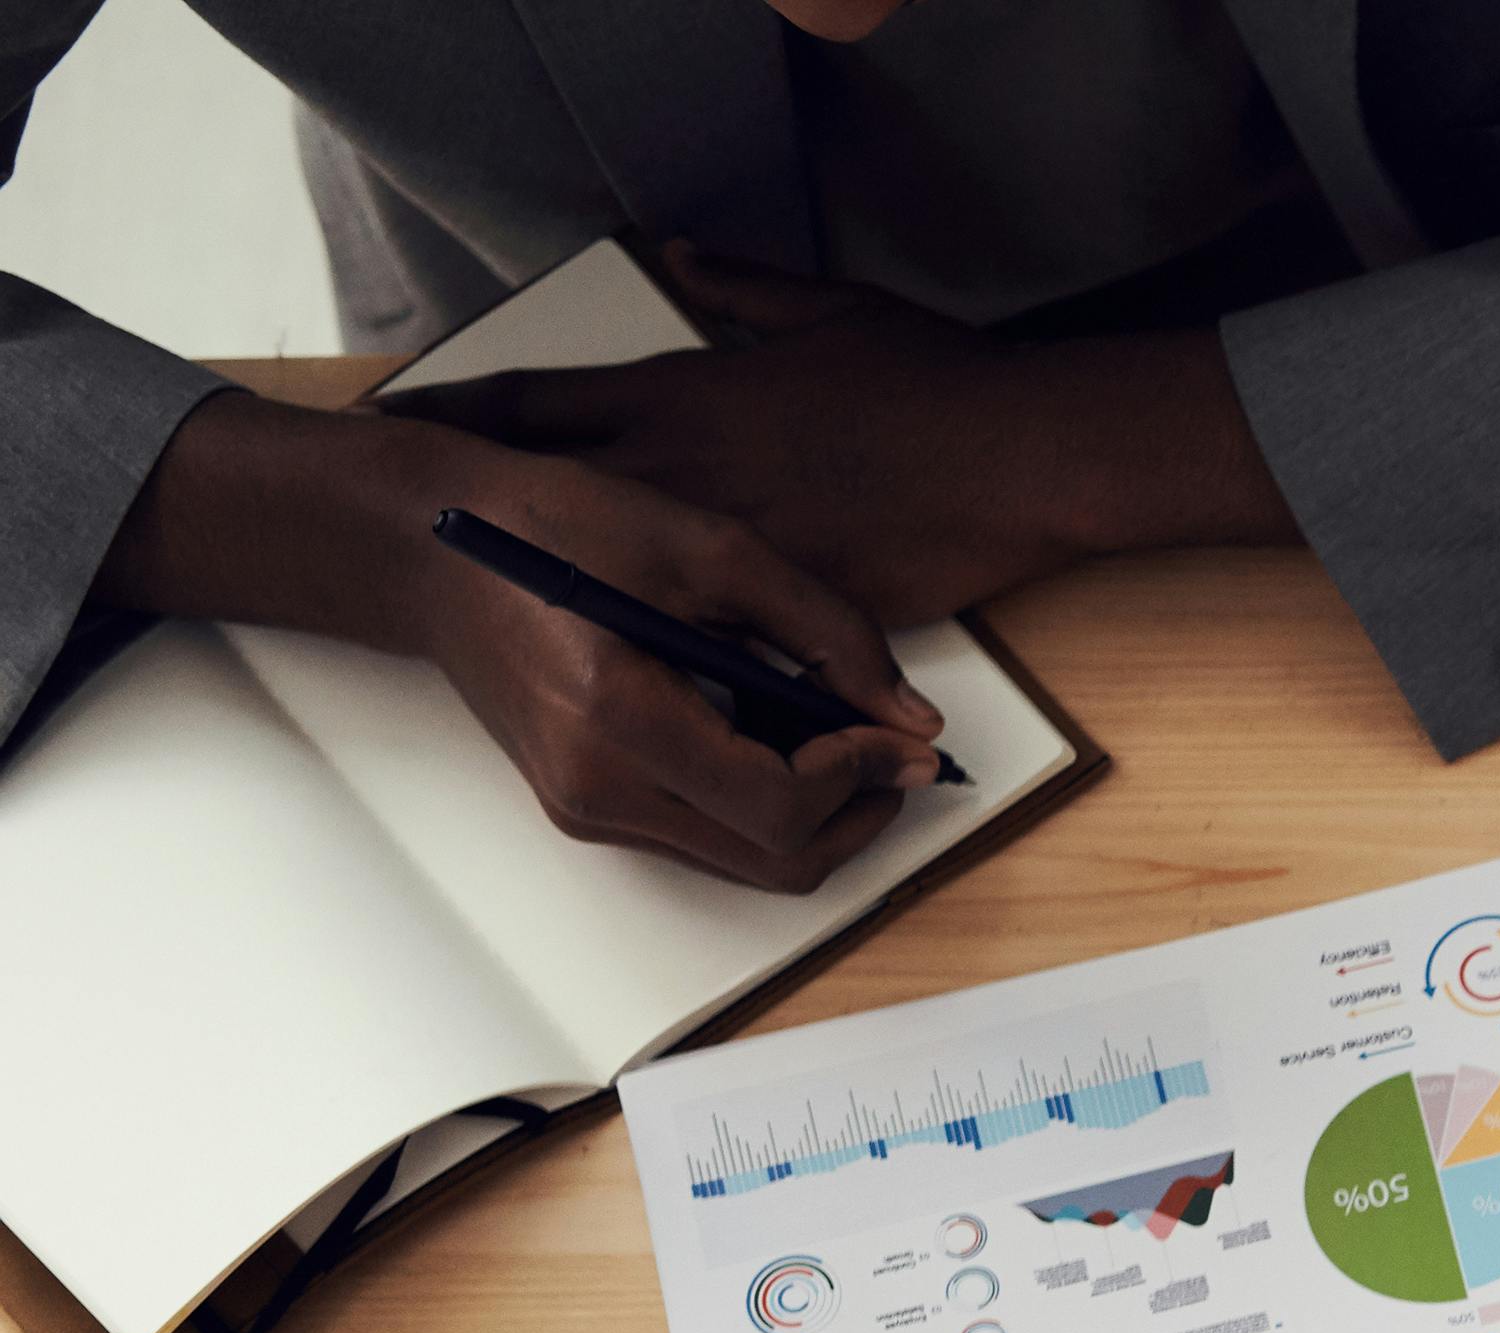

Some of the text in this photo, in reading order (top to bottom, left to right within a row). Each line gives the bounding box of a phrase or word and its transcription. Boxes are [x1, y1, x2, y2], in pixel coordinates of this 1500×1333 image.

[1319, 939, 1391, 967] Efficiency
[1328, 981, 1401, 1009] Retention
[1279, 1024, 1413, 1067] Customer Service
[1334, 1174, 1409, 1215] 50%
[1447, 1312, 1475, 1325] 50%
